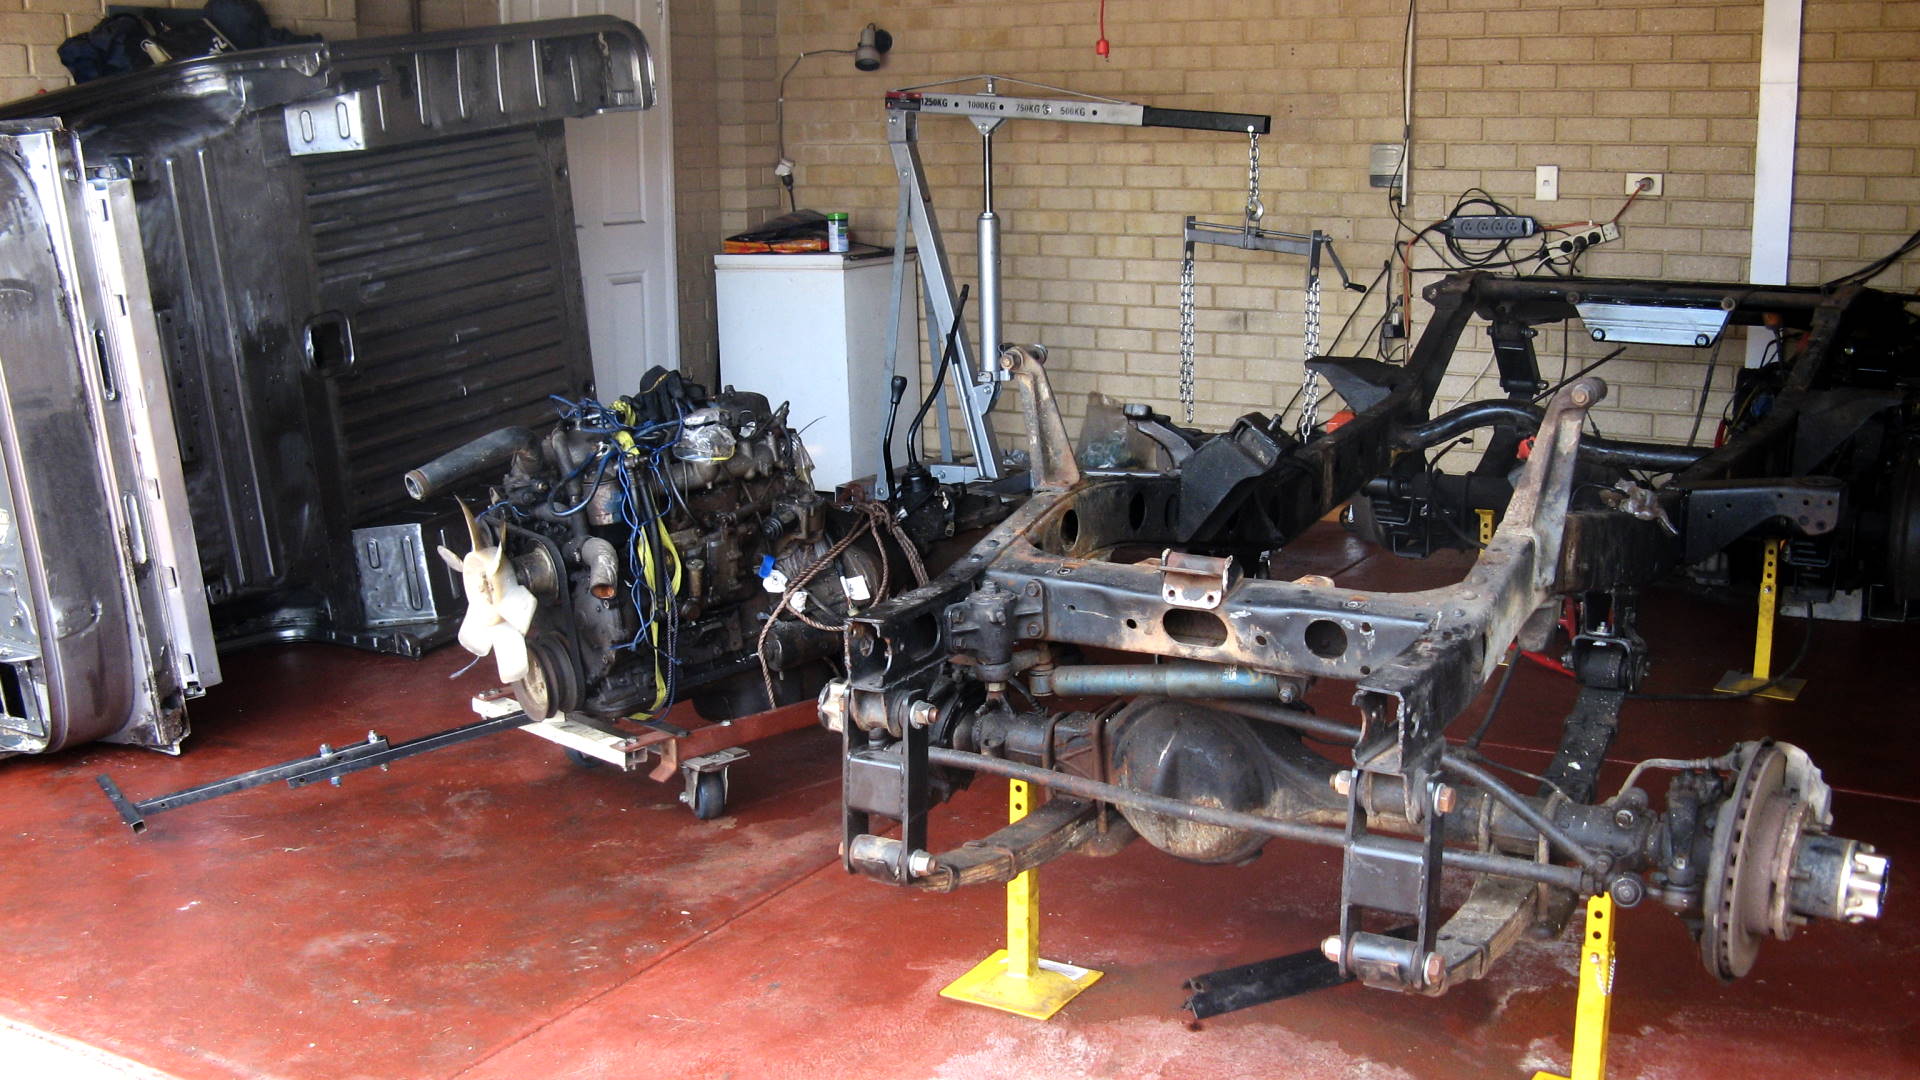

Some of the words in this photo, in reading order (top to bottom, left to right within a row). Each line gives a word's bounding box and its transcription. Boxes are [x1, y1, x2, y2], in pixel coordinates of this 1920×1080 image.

[921, 97, 948, 107] 1250KG
[968, 100, 996, 111] 1000KG
[1015, 103, 1040, 114] 750KG
[1060, 106, 1086, 117] 500KG
